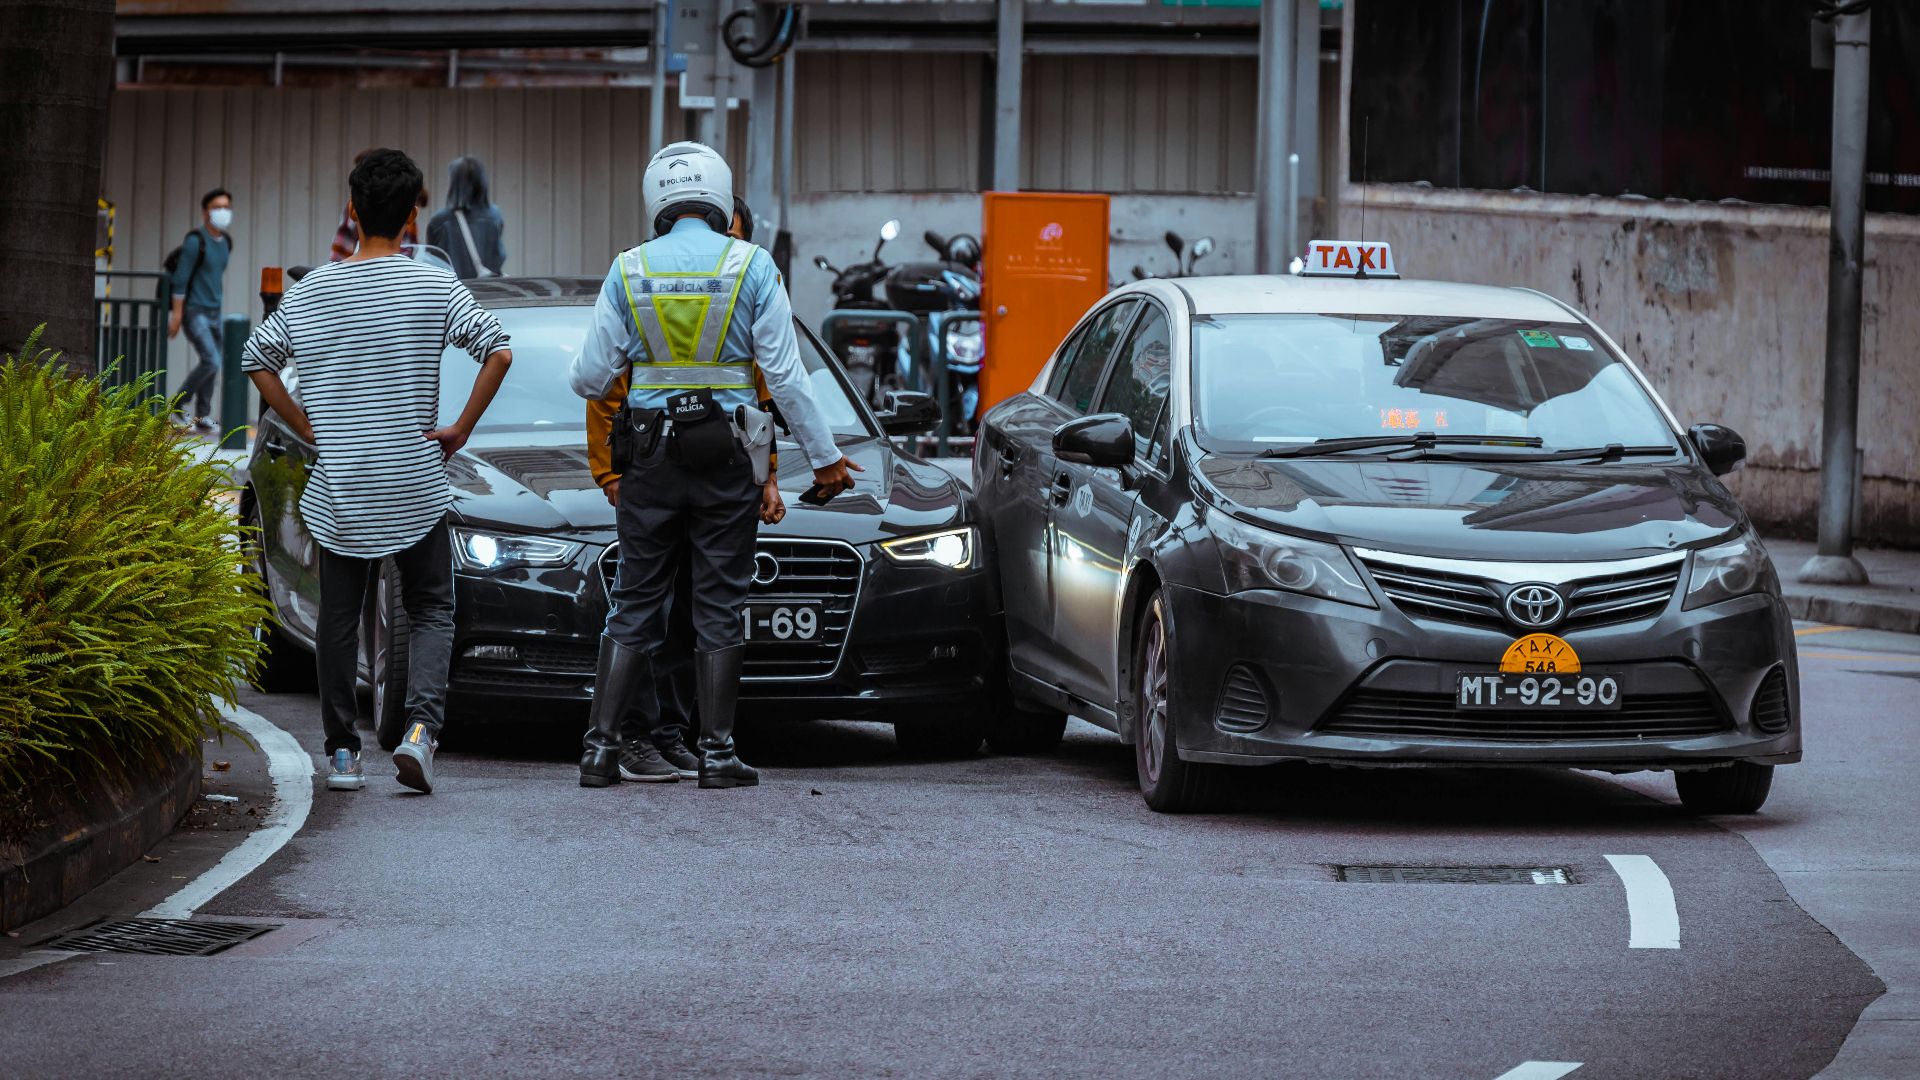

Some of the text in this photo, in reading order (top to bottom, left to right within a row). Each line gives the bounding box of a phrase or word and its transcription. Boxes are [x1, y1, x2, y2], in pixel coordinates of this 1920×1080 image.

[1316, 245, 1386, 269] TAXI
[660, 280, 703, 293] POLÍCIA
[676, 403, 704, 413] POLÍCIA
[1515, 638, 1565, 659] TAXI
[1524, 661, 1556, 673] 548
[1461, 676, 1618, 705] MT-92-90
